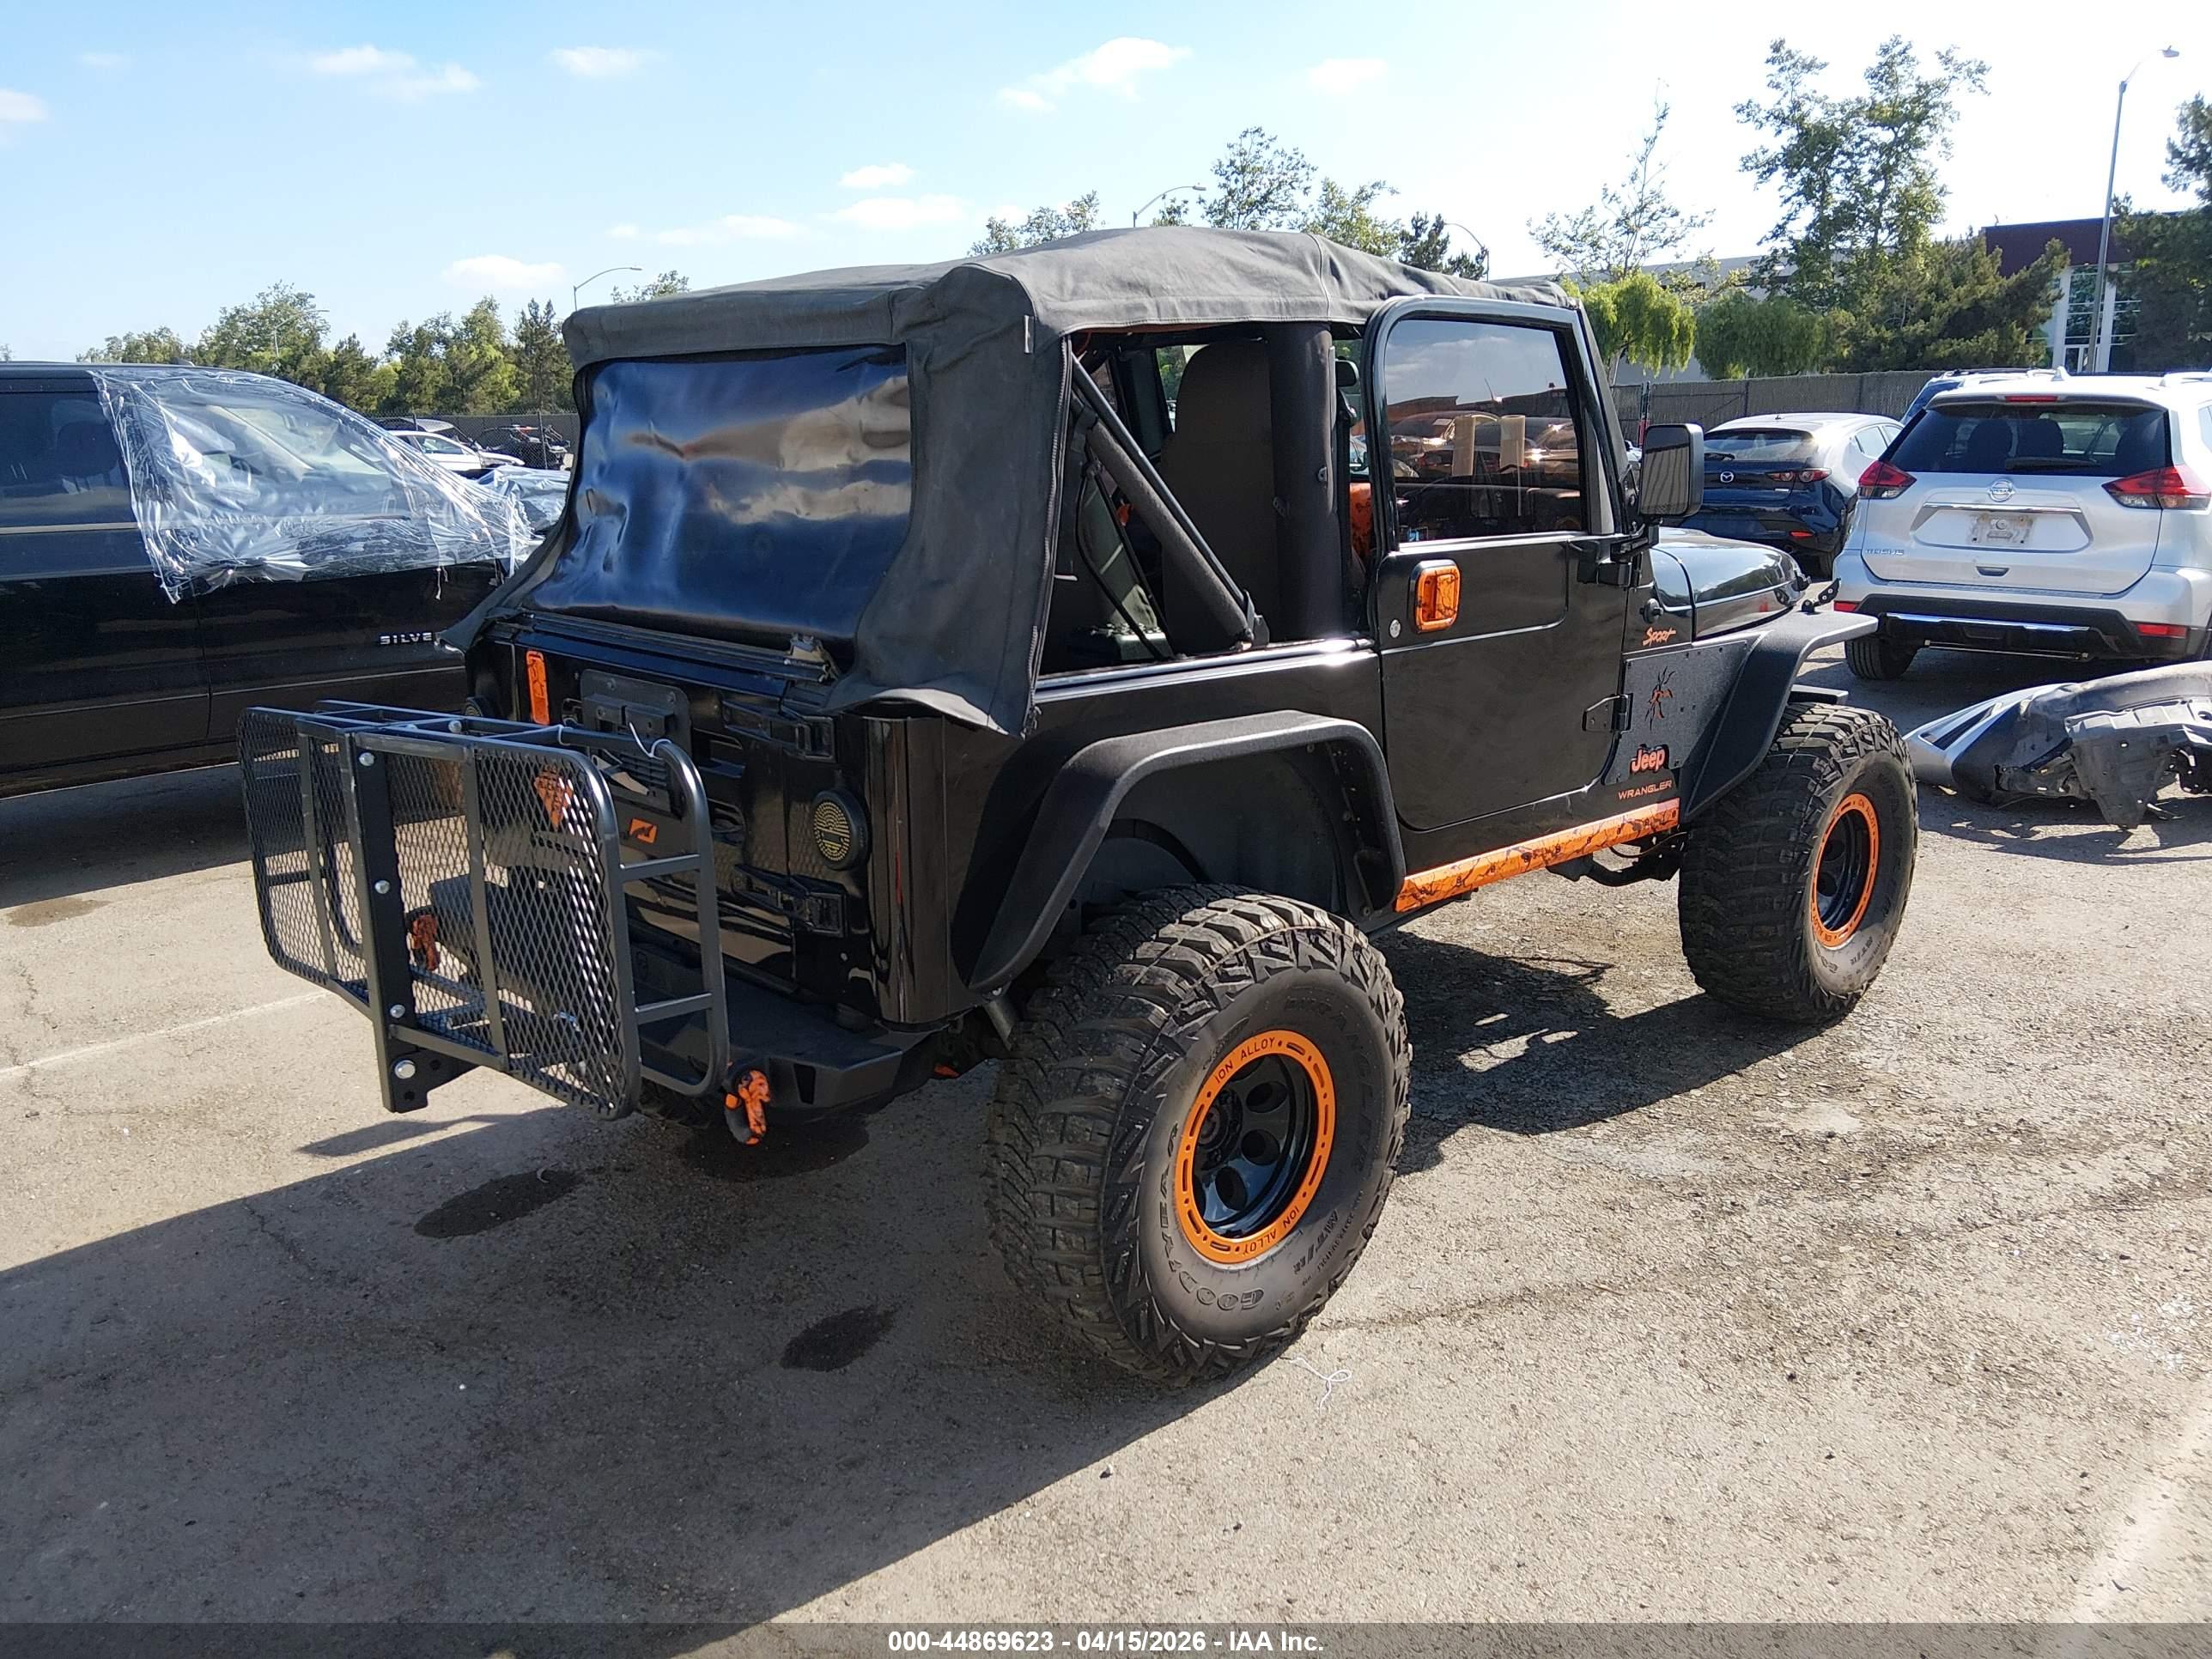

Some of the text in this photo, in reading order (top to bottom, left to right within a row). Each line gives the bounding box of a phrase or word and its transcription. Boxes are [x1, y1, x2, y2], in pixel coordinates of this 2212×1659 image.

[1643, 627, 1676, 647] Sport
[1631, 746, 1667, 773] Jeep
[1618, 780, 1673, 800] WRANGLER
[1214, 1037, 1275, 1084] ION ALLOY
[1243, 1206, 1300, 1255] ION ALLOY
